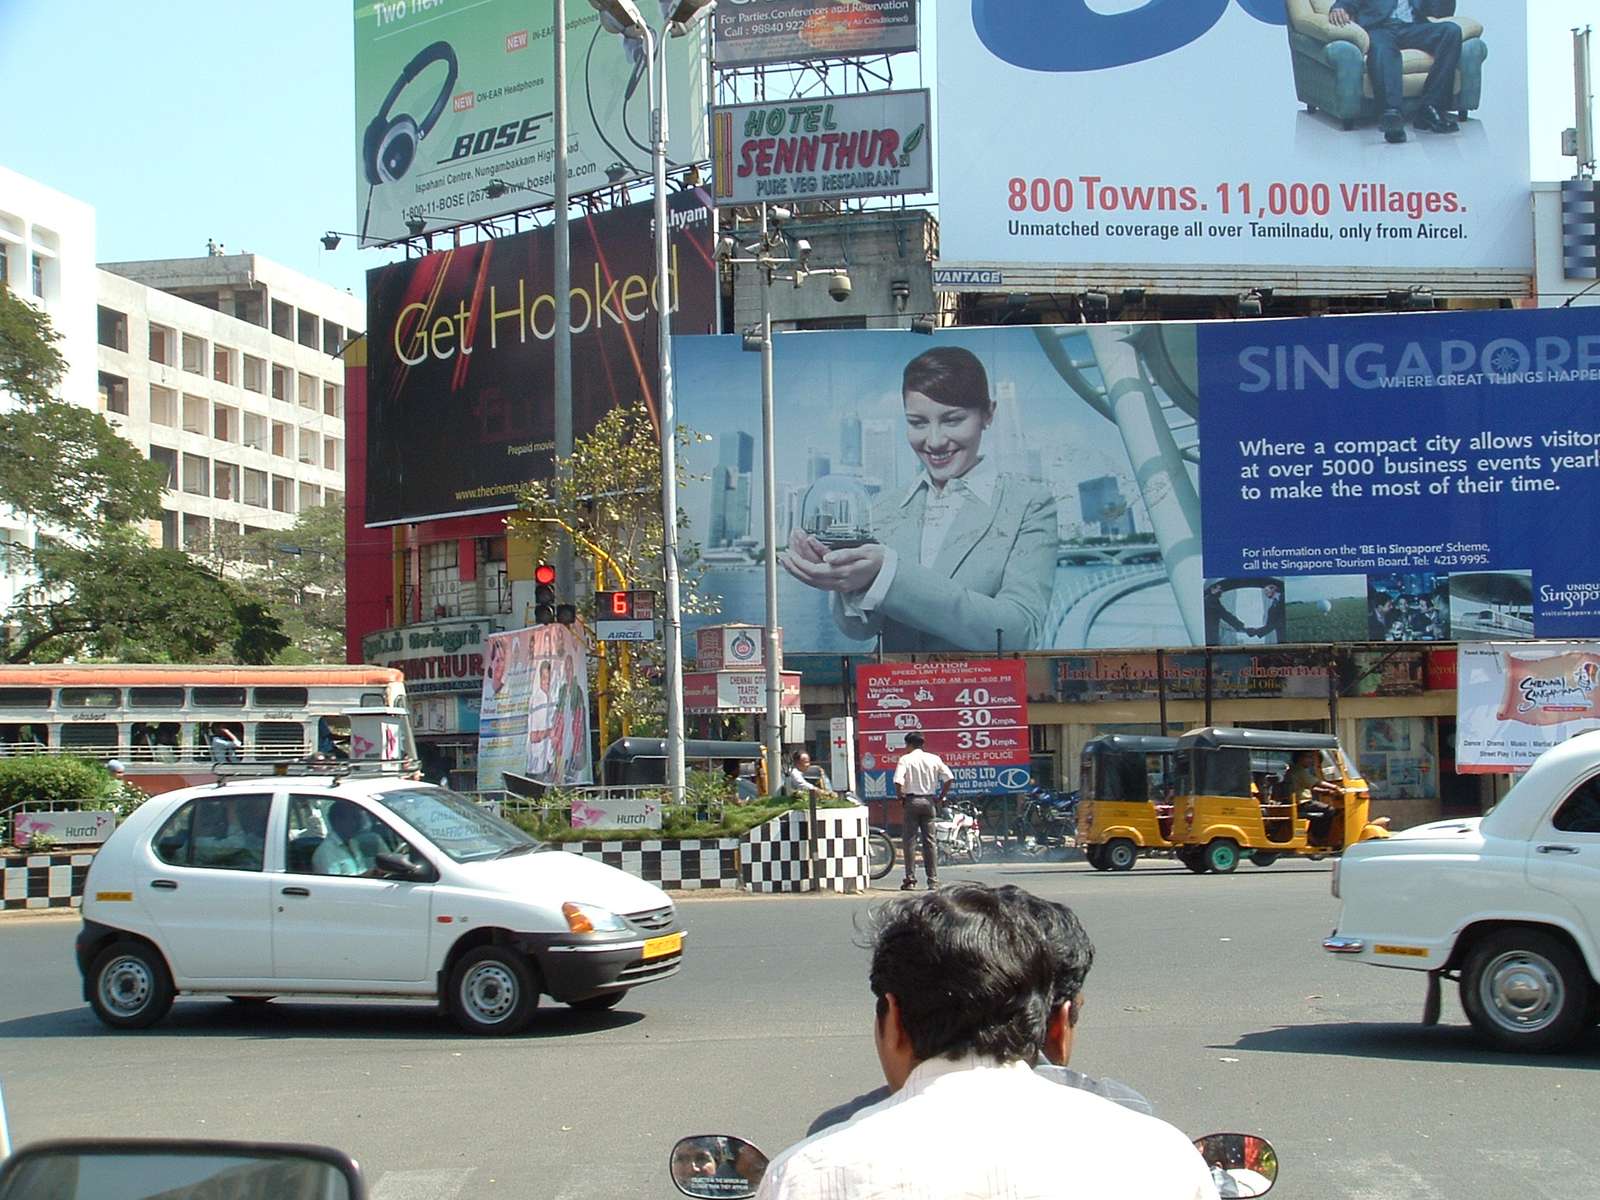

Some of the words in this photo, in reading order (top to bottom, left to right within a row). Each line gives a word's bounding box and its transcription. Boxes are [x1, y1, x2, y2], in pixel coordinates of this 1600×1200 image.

[373, 2, 406, 28] Two
[720, 14, 736, 25] For
[851, 0, 909, 13] Reservation
[724, 26, 743, 38] Call
[751, 22, 783, 35] 98840
[507, 33, 528, 49] NEW
[454, 95, 473, 109] NEW
[744, 103, 838, 137] HOTEL
[436, 112, 553, 165] BOSE
[737, 128, 900, 178] SENNTHUR
[756, 178, 787, 197] PURE
[790, 176, 817, 193] VEG
[822, 170, 901, 191] RESTAURANT
[1007, 177, 1074, 213] 800
[1078, 176, 1208, 211] Towns.
[1215, 181, 1331, 219] 11,000
[1339, 183, 1468, 220] Villages.
[1008, 219, 1100, 237] Unmatched
[1105, 222, 1179, 241] coverage
[1184, 221, 1202, 237] all
[1208, 224, 1242, 238] over
[1249, 222, 1334, 241] Tamilnadu,
[1339, 223, 1375, 242] only
[1376, 223, 1412, 239] from
[1416, 223, 1468, 239] Aircel.
[934, 271, 1001, 283] VANTAGE
[393, 299, 473, 367] Get
[1379, 374, 1433, 389] WHERE
[1436, 372, 1484, 387] GREAT
[1488, 370, 1544, 385] THINGS
[1240, 438, 1305, 457] Where
[1314, 442, 1326, 455] a
[1334, 437, 1417, 457] compact
[1426, 435, 1461, 454] city
[1469, 431, 1533, 450] allows
[1240, 464, 1260, 479] at
[1268, 463, 1313, 478] over
[1322, 459, 1374, 476] 5000
[1384, 457, 1468, 475] business
[1476, 455, 1542, 471] events
[1240, 484, 1261, 500] to
[1269, 480, 1323, 499] make
[1331, 479, 1363, 498] the
[1371, 479, 1421, 496] most
[1429, 476, 1451, 494] of
[1457, 476, 1503, 494] their
[1511, 475, 1561, 492] time.
[1243, 548, 1260, 558] For
[1262, 546, 1322, 558] information
[1323, 547, 1338, 556] on
[1340, 545, 1357, 556] the
[1377, 545, 1387, 554] in
[1243, 560, 1260, 570] call
[1262, 560, 1279, 570] the
[1281, 558, 1333, 571] Singapore
[1335, 557, 1375, 569] Tourism
[1377, 556, 1412, 567] Board.
[1434, 555, 1458, 565] 4213
[613, 592, 627, 614] 6
[891, 669, 917, 677] SPEED
[913, 662, 969, 670] CAUTION
[868, 678, 891, 687] DAY
[955, 688, 990, 706] 40
[957, 709, 992, 727] 30
[956, 731, 991, 750] 35
[945, 752, 980, 761] TRAFFIC
[983, 751, 1014, 760] POLICE
[979, 767, 997, 779] LTD
